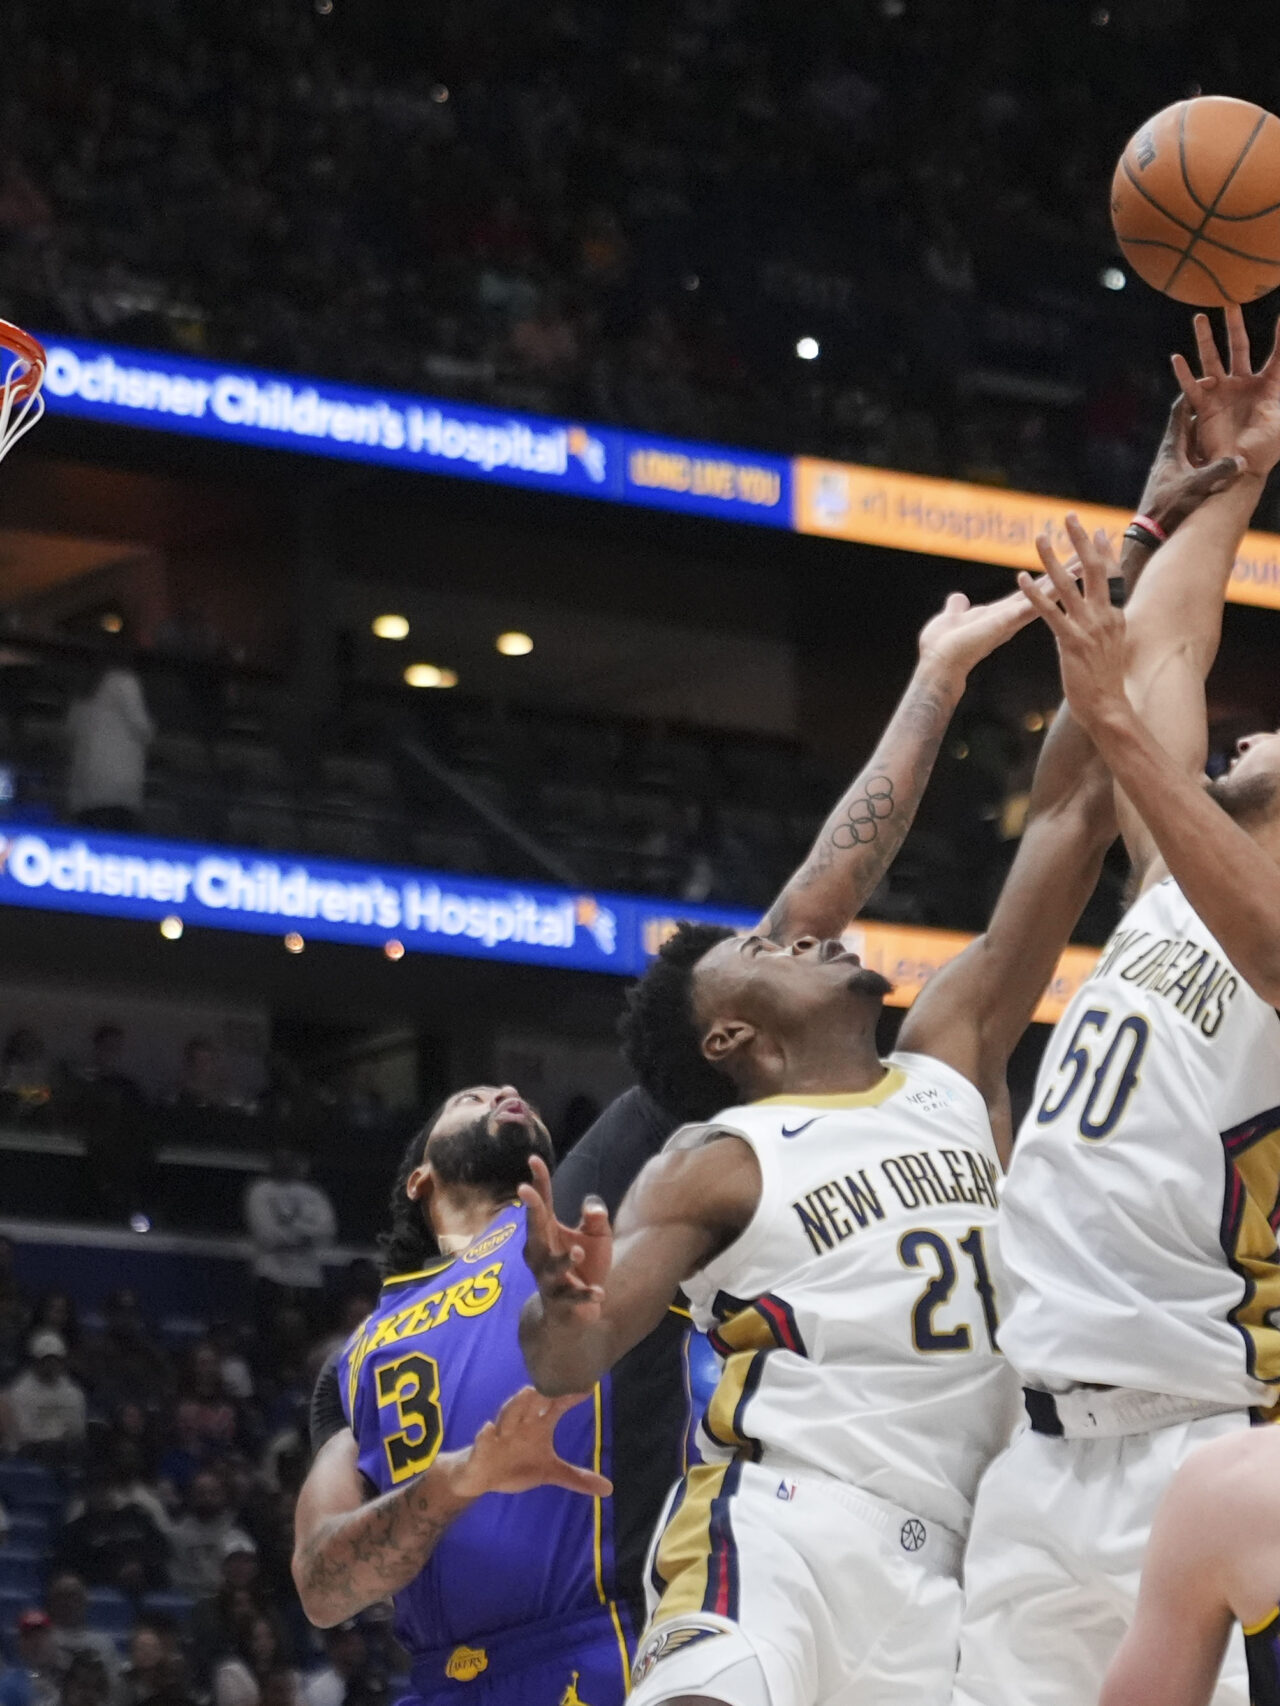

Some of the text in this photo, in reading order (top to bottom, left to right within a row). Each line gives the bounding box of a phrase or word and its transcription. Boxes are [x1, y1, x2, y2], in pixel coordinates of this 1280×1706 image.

[44, 346, 569, 476] Ochsner Children's Hospital
[898, 496, 1034, 546] Hospital
[10, 834, 192, 903] Ochsner
[193, 857, 401, 928] Children's
[402, 883, 576, 949] Hospital
[1036, 1006, 1151, 1143] 50
[790, 1150, 1000, 1256] NEW ORLEAN
[897, 1226, 1003, 1356] 21
[374, 1351, 444, 1485] 3
